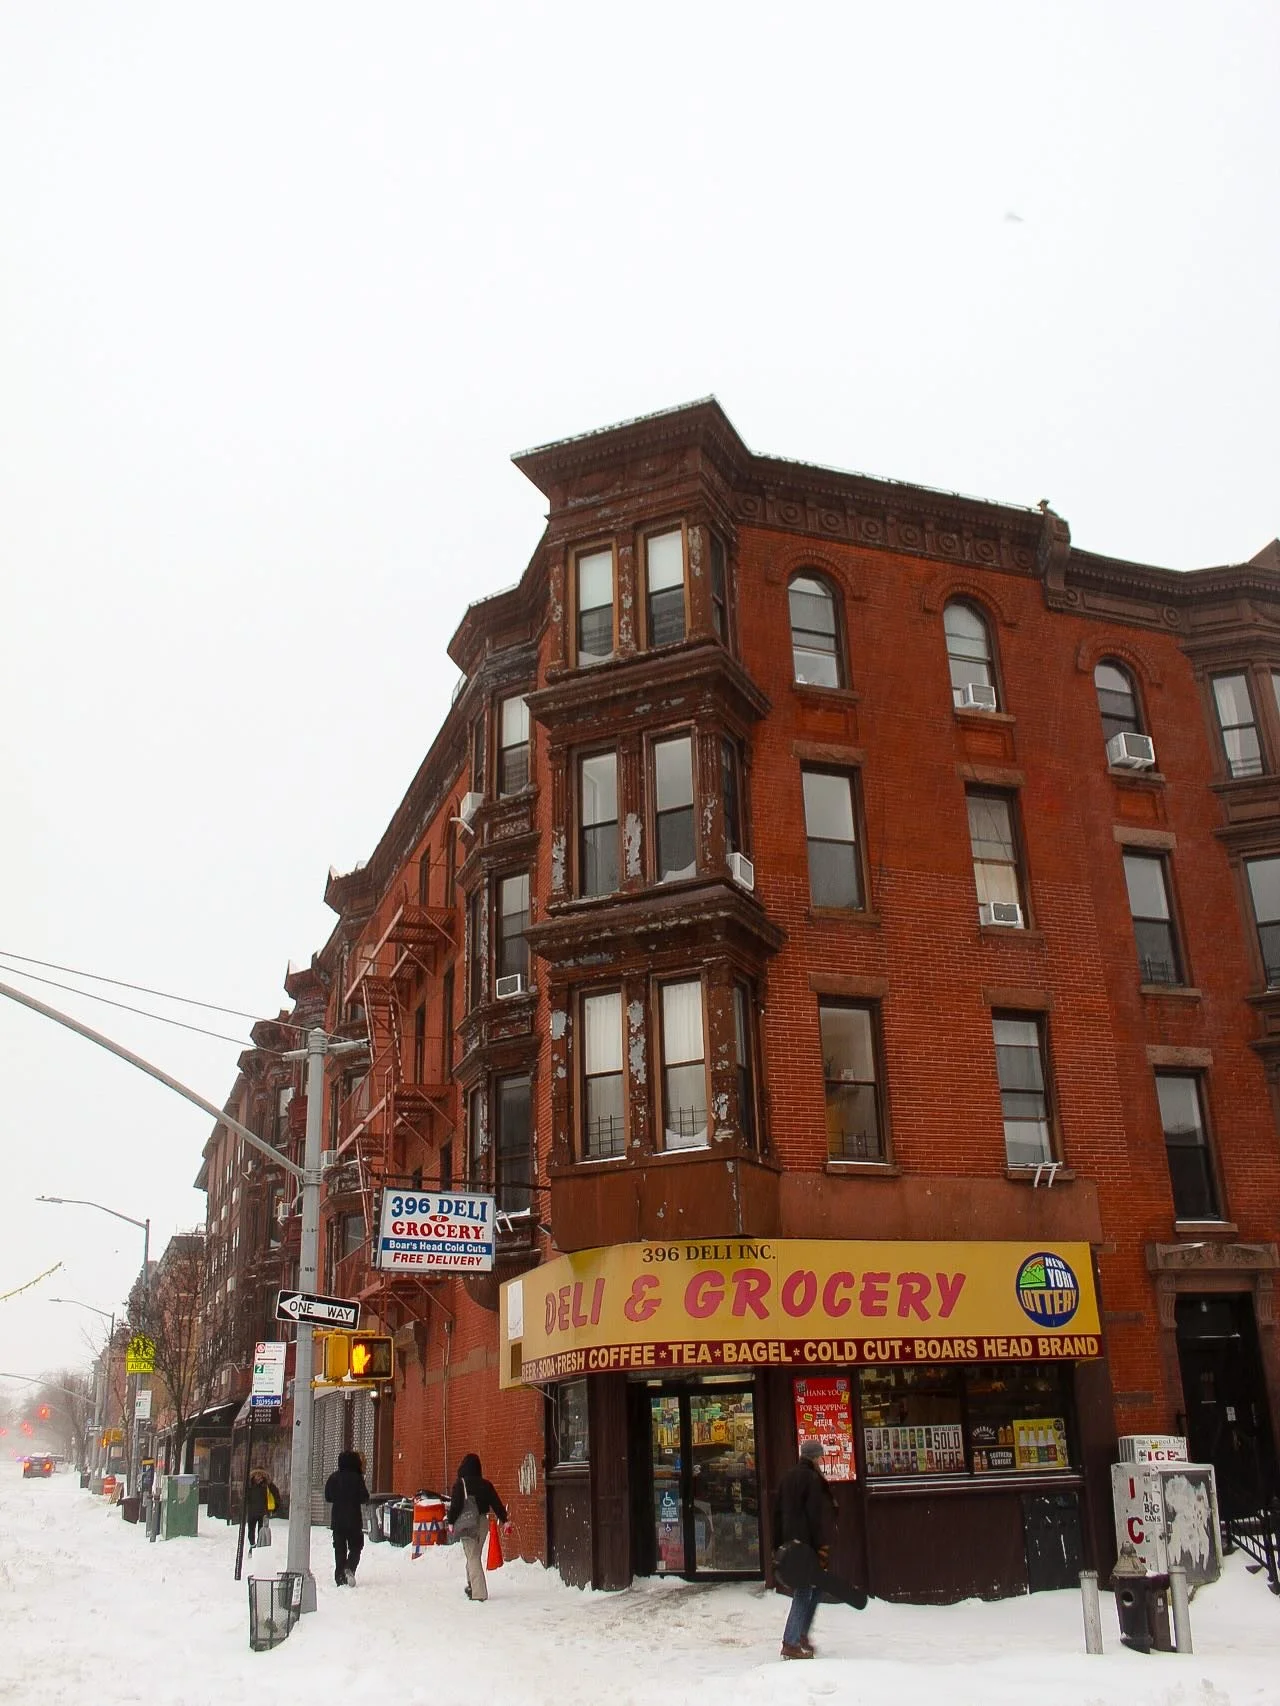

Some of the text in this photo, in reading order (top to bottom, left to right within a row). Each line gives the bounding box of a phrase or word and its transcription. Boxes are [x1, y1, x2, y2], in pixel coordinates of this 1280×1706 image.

[391, 1195, 488, 1223] 396 DELI
[391, 1221, 484, 1240] GROCERY
[389, 1239, 487, 1253] Boar's Head Cold Cuts
[642, 1244, 776, 1263] 396 DELI INC.
[393, 1252, 482, 1266] FREE DELIVERY
[1044, 1257, 1066, 1269] NEW
[1047, 1268, 1075, 1288] YORK
[289, 1300, 352, 1320] ONE WAY
[545, 1267, 967, 1336] DELI & GROCERY
[1019, 1289, 1077, 1315] LOTTERY
[557, 1350, 585, 1375] FRESH
[588, 1344, 656, 1369] COFFEE
[668, 1343, 713, 1364] TEA
[723, 1341, 793, 1363] BAGEL
[804, 1341, 857, 1362] COLD
[863, 1340, 903, 1360] CUT
[914, 1338, 978, 1359] BOARS
[983, 1338, 1033, 1357] HEAD
[1037, 1336, 1099, 1356] BRAND
[131, 1361, 153, 1370] AHEAD
[813, 1403, 847, 1412] SHOPPING
[935, 1450, 963, 1470] HERE
